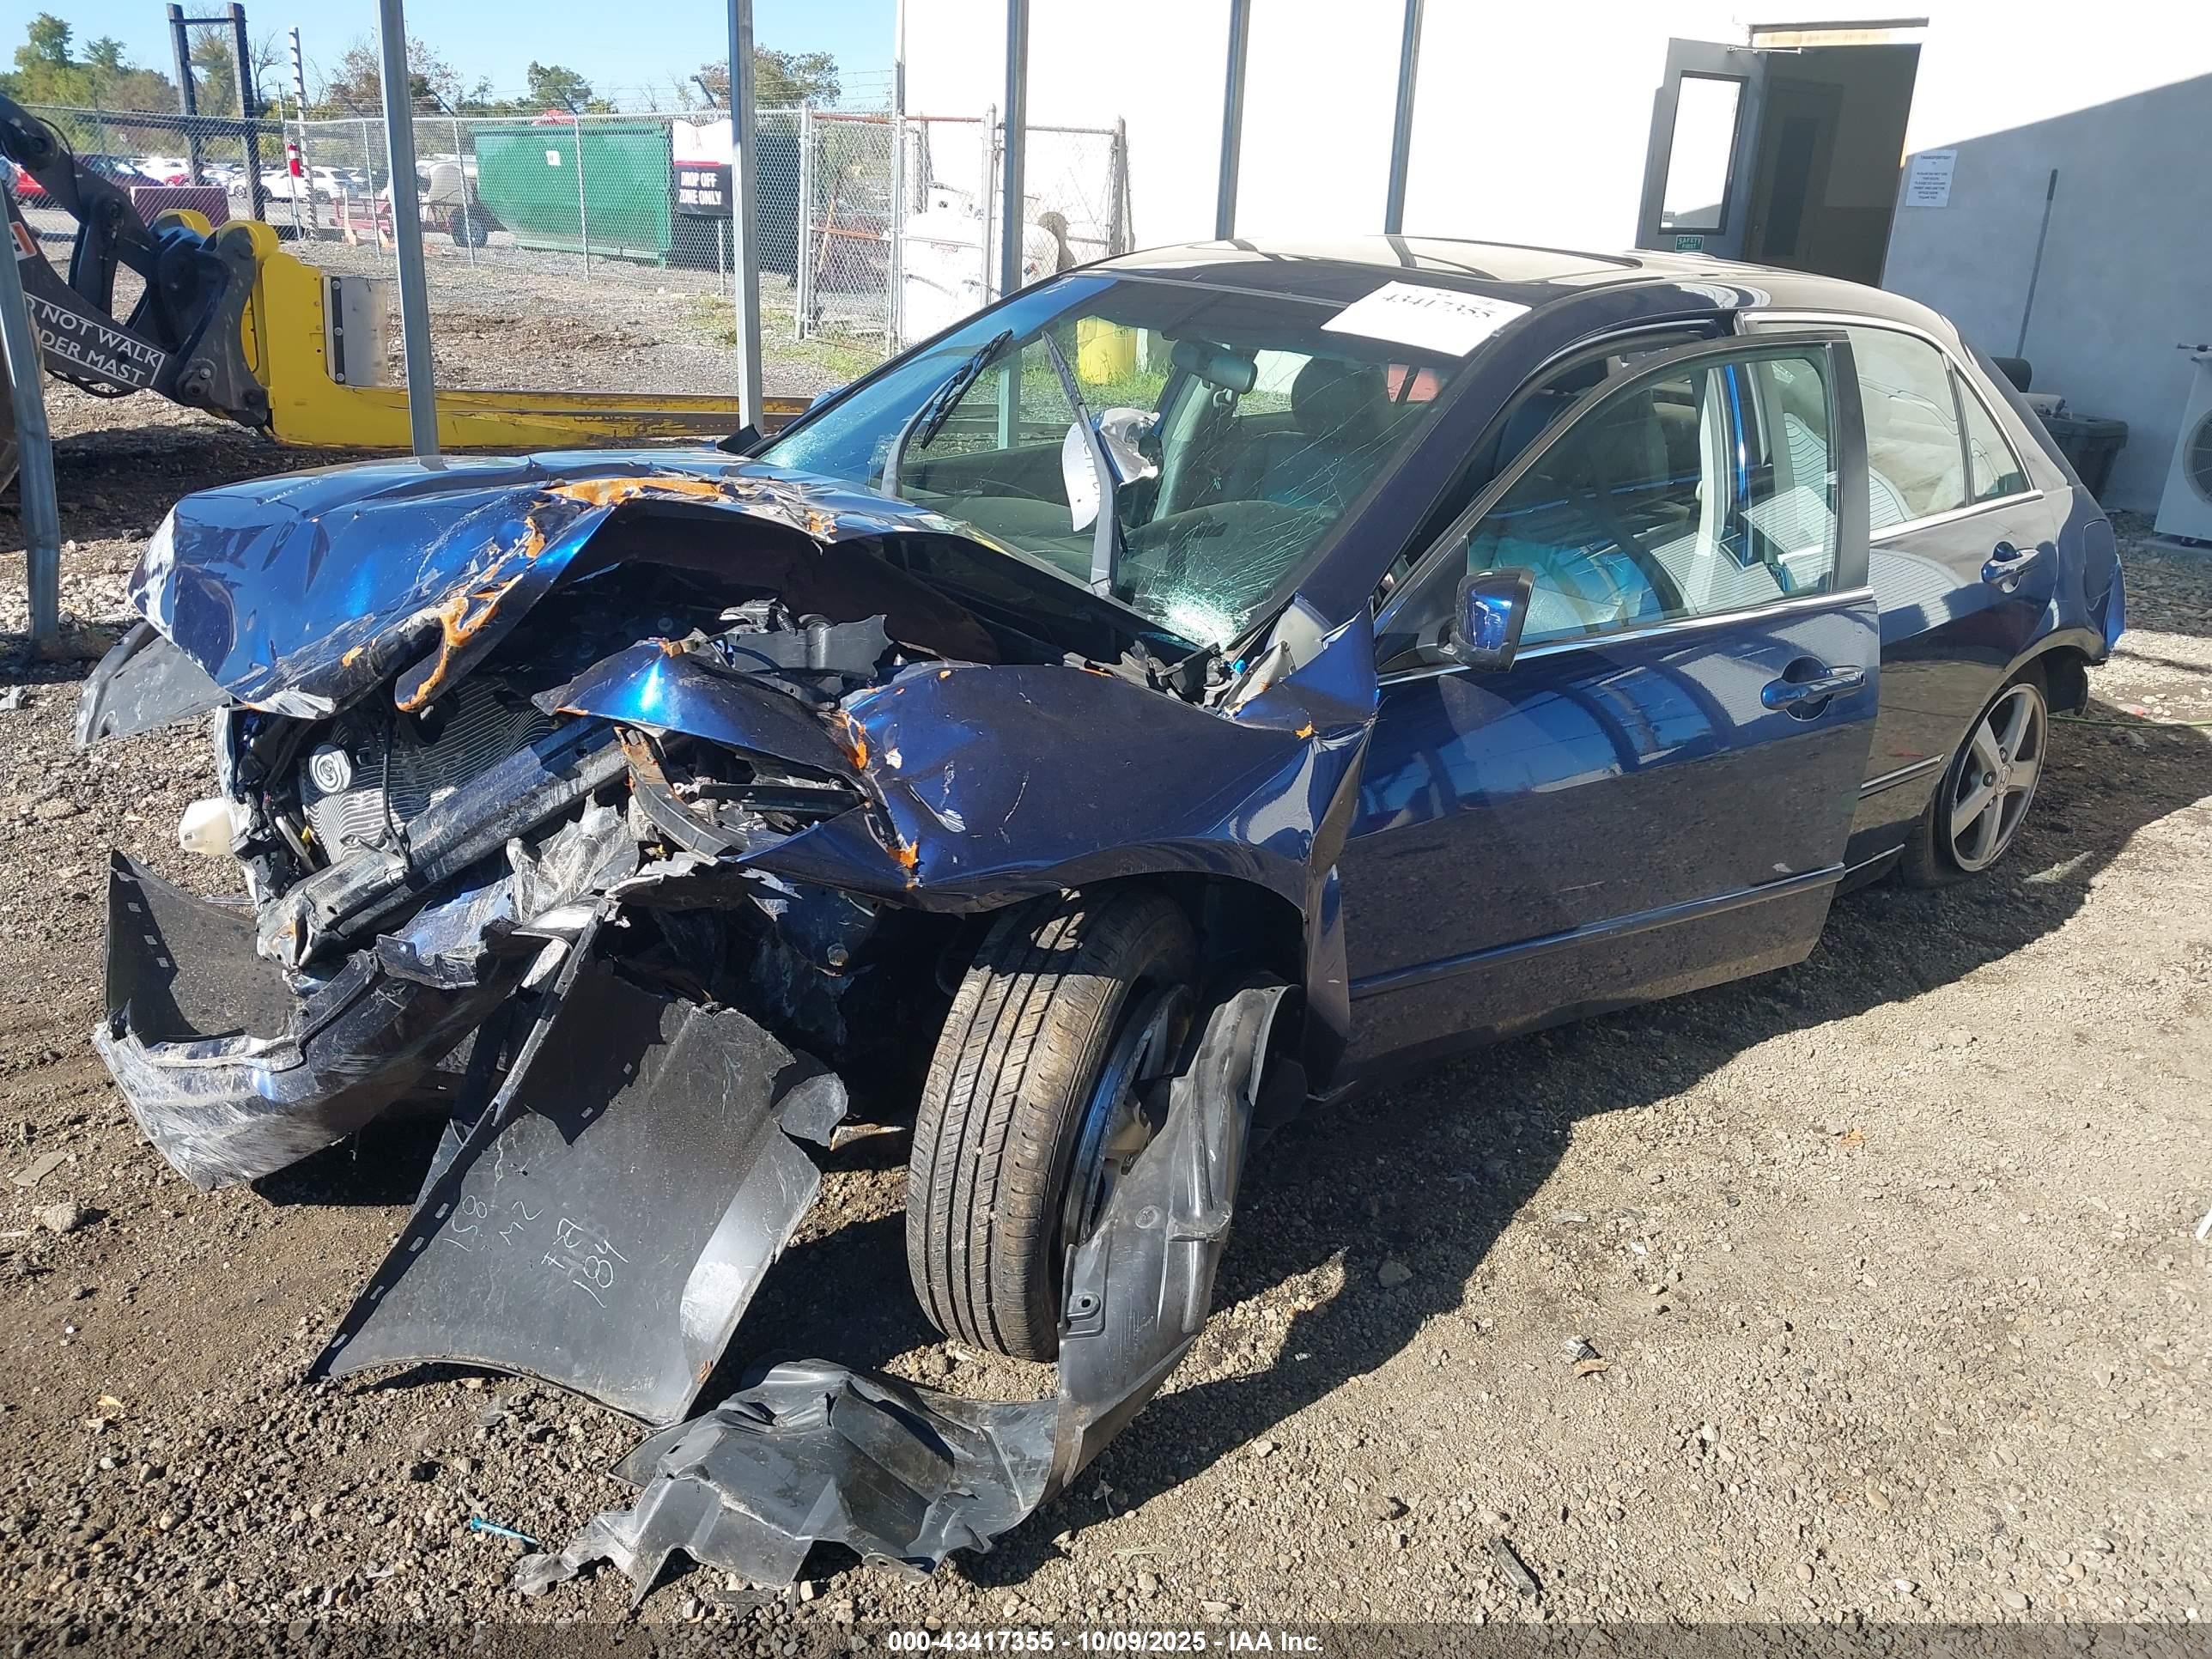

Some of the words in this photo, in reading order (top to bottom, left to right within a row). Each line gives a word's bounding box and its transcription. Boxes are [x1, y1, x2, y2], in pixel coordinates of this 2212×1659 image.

[678, 188, 698, 204] ZONE
[698, 190, 721, 205] ONLY
[680, 172, 700, 187] DROP
[701, 172, 718, 188] OFF
[1677, 237, 1701, 246] SAFETY
[40, 307, 94, 337] NOT
[98, 327, 161, 368] WALK
[40, 329, 82, 360] DER
[86, 349, 145, 384] MAST
[573, 1239, 629, 1309] 184
